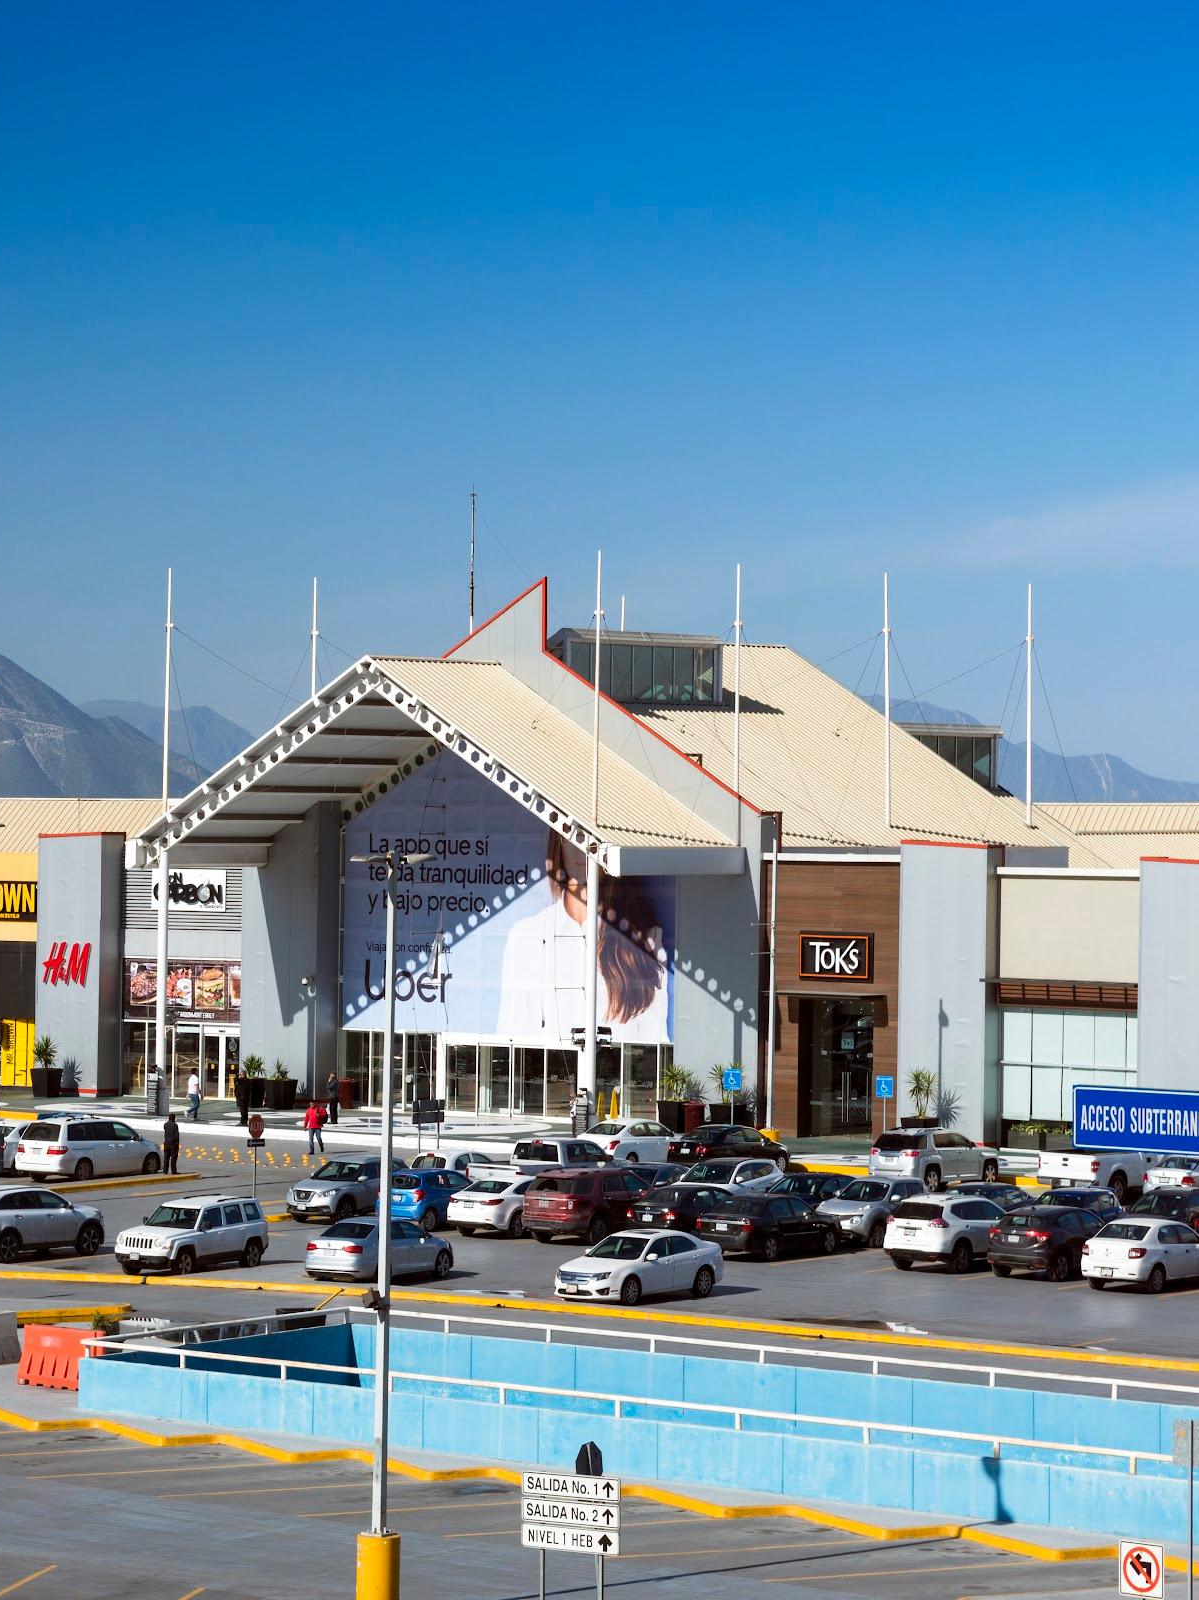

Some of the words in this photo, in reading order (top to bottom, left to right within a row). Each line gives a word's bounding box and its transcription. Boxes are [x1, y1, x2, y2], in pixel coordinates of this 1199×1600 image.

[369, 833, 389, 853] La
[394, 838, 431, 856] app
[435, 838, 470, 861] que
[475, 834, 489, 856] sí
[419, 864, 528, 889] tranquilidad
[368, 894, 378, 915] y
[428, 891, 489, 916] precio.
[43, 942, 92, 988] H&M
[1081, 1105, 1125, 1133] ACCESO
[527, 1476, 568, 1493] SALIDA
[572, 1480, 590, 1495] No.
[593, 1483, 598, 1495] 1
[526, 1502, 567, 1520] SALIDA
[571, 1507, 589, 1522] No.
[592, 1509, 599, 1522] 2
[528, 1528, 559, 1545] NIVEL
[562, 1532, 566, 1546] 1
[571, 1533, 593, 1548] HEB
